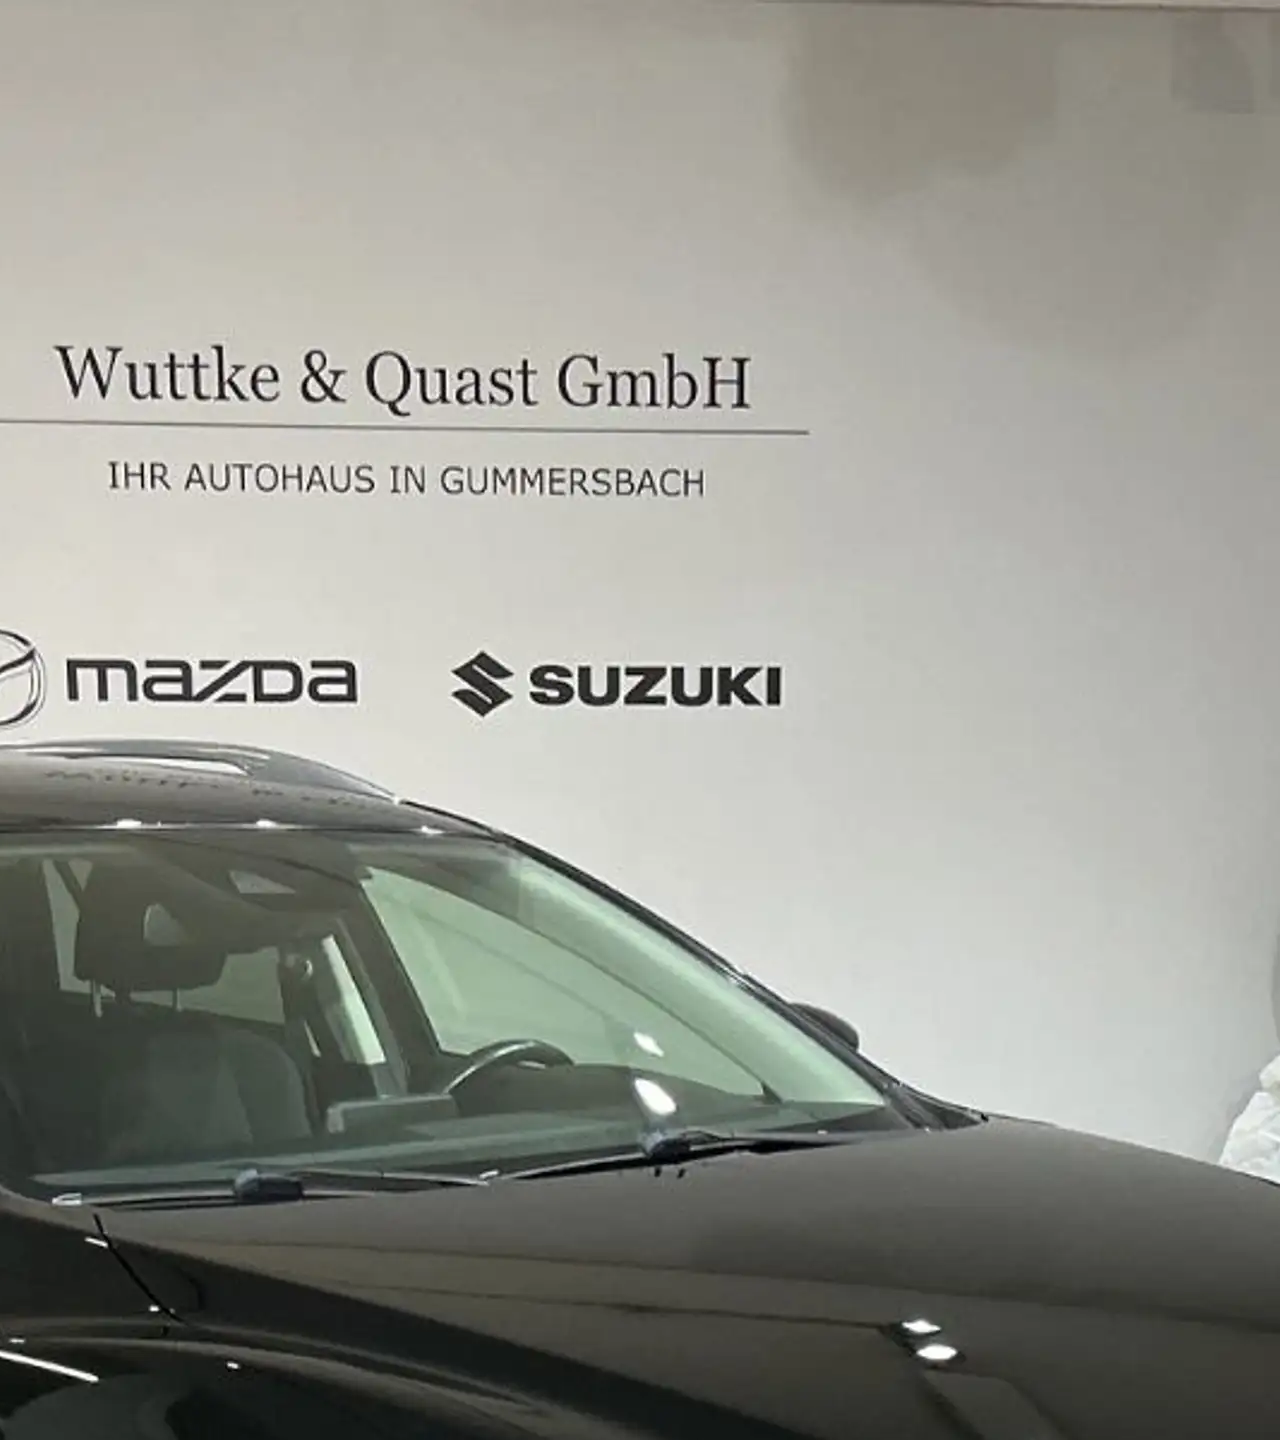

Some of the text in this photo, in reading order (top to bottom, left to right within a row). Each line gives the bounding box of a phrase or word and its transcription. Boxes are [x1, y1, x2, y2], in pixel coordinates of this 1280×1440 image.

[52, 344, 753, 419] Wuttke & Quast GmbH
[108, 460, 704, 498] IHR AUTOHAUS IN GUMMERSBACH
[65, 657, 359, 705] mazda
[528, 663, 783, 708] SUZUKI
